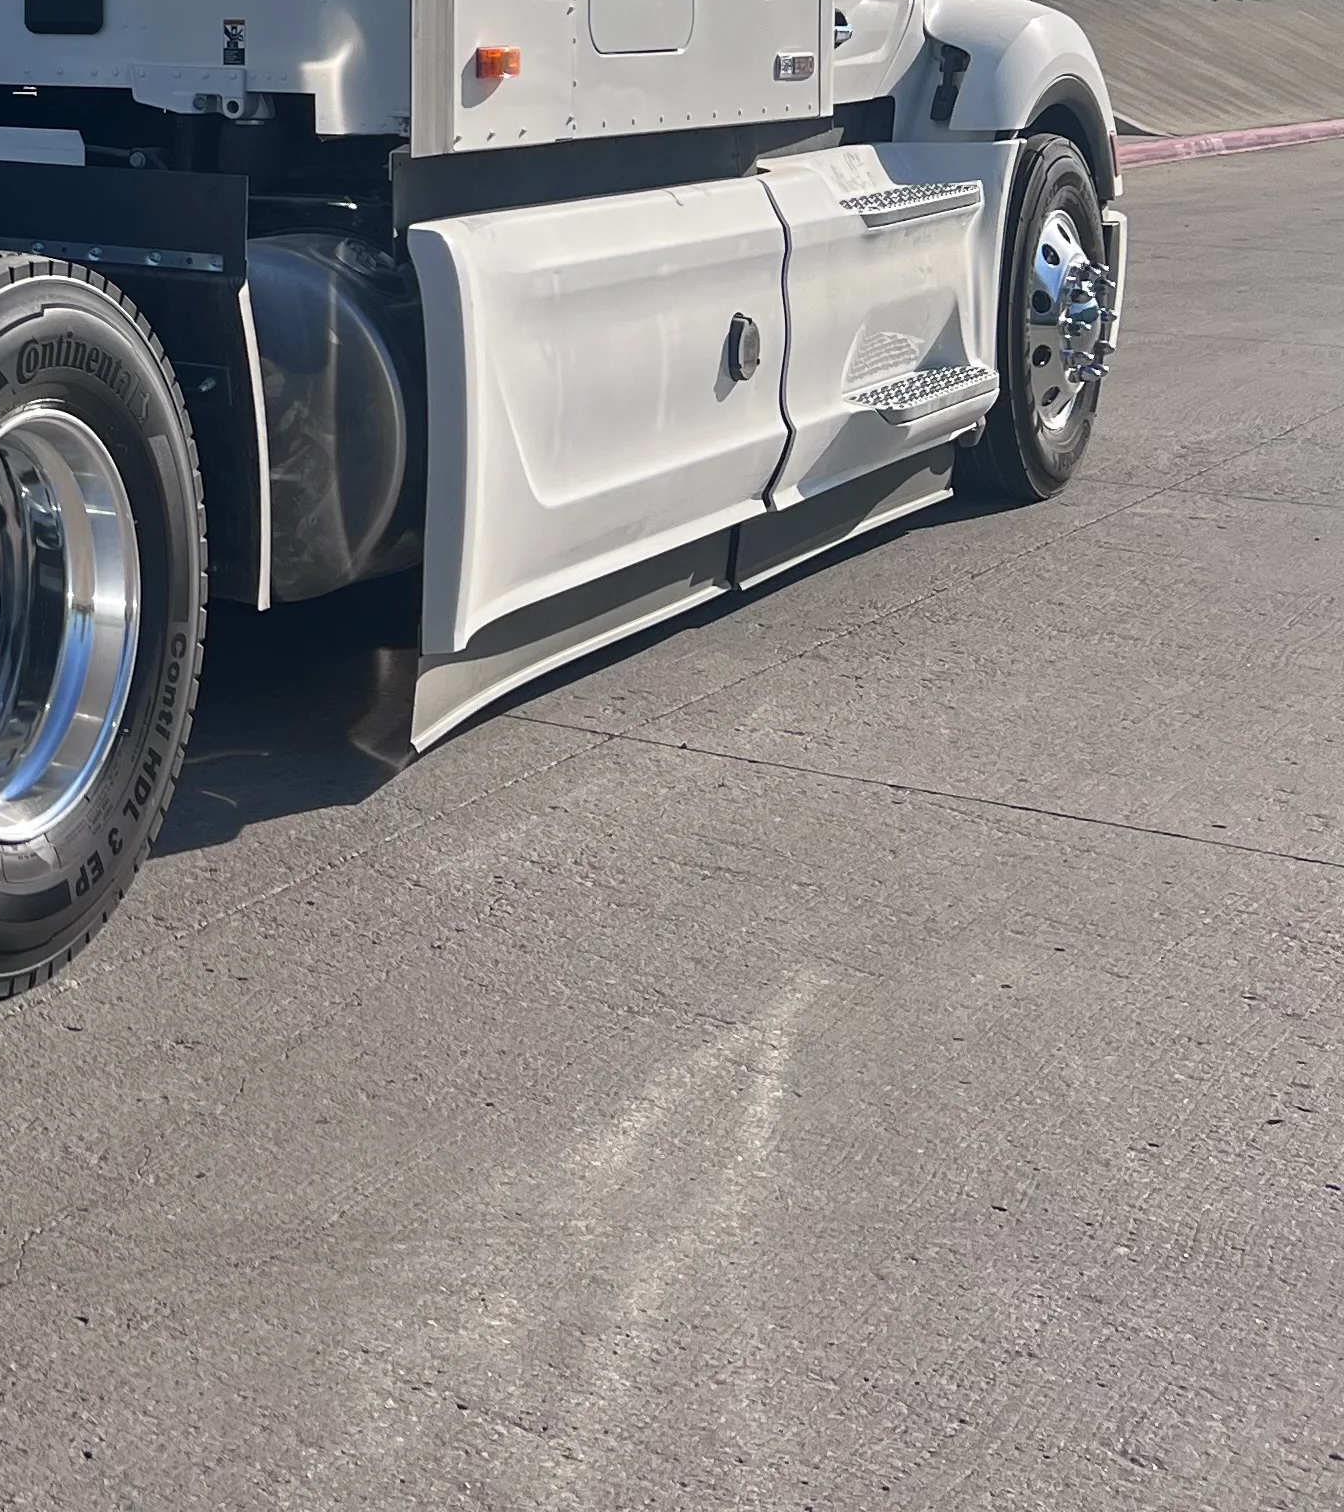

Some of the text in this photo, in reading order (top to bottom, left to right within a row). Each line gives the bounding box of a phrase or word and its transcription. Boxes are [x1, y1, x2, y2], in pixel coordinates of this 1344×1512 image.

[16, 330, 141, 406] Continental
[154, 632, 187, 743] Conti
[122, 746, 163, 824] HDL
[75, 849, 105, 898] EP
[107, 827, 124, 856] 3
